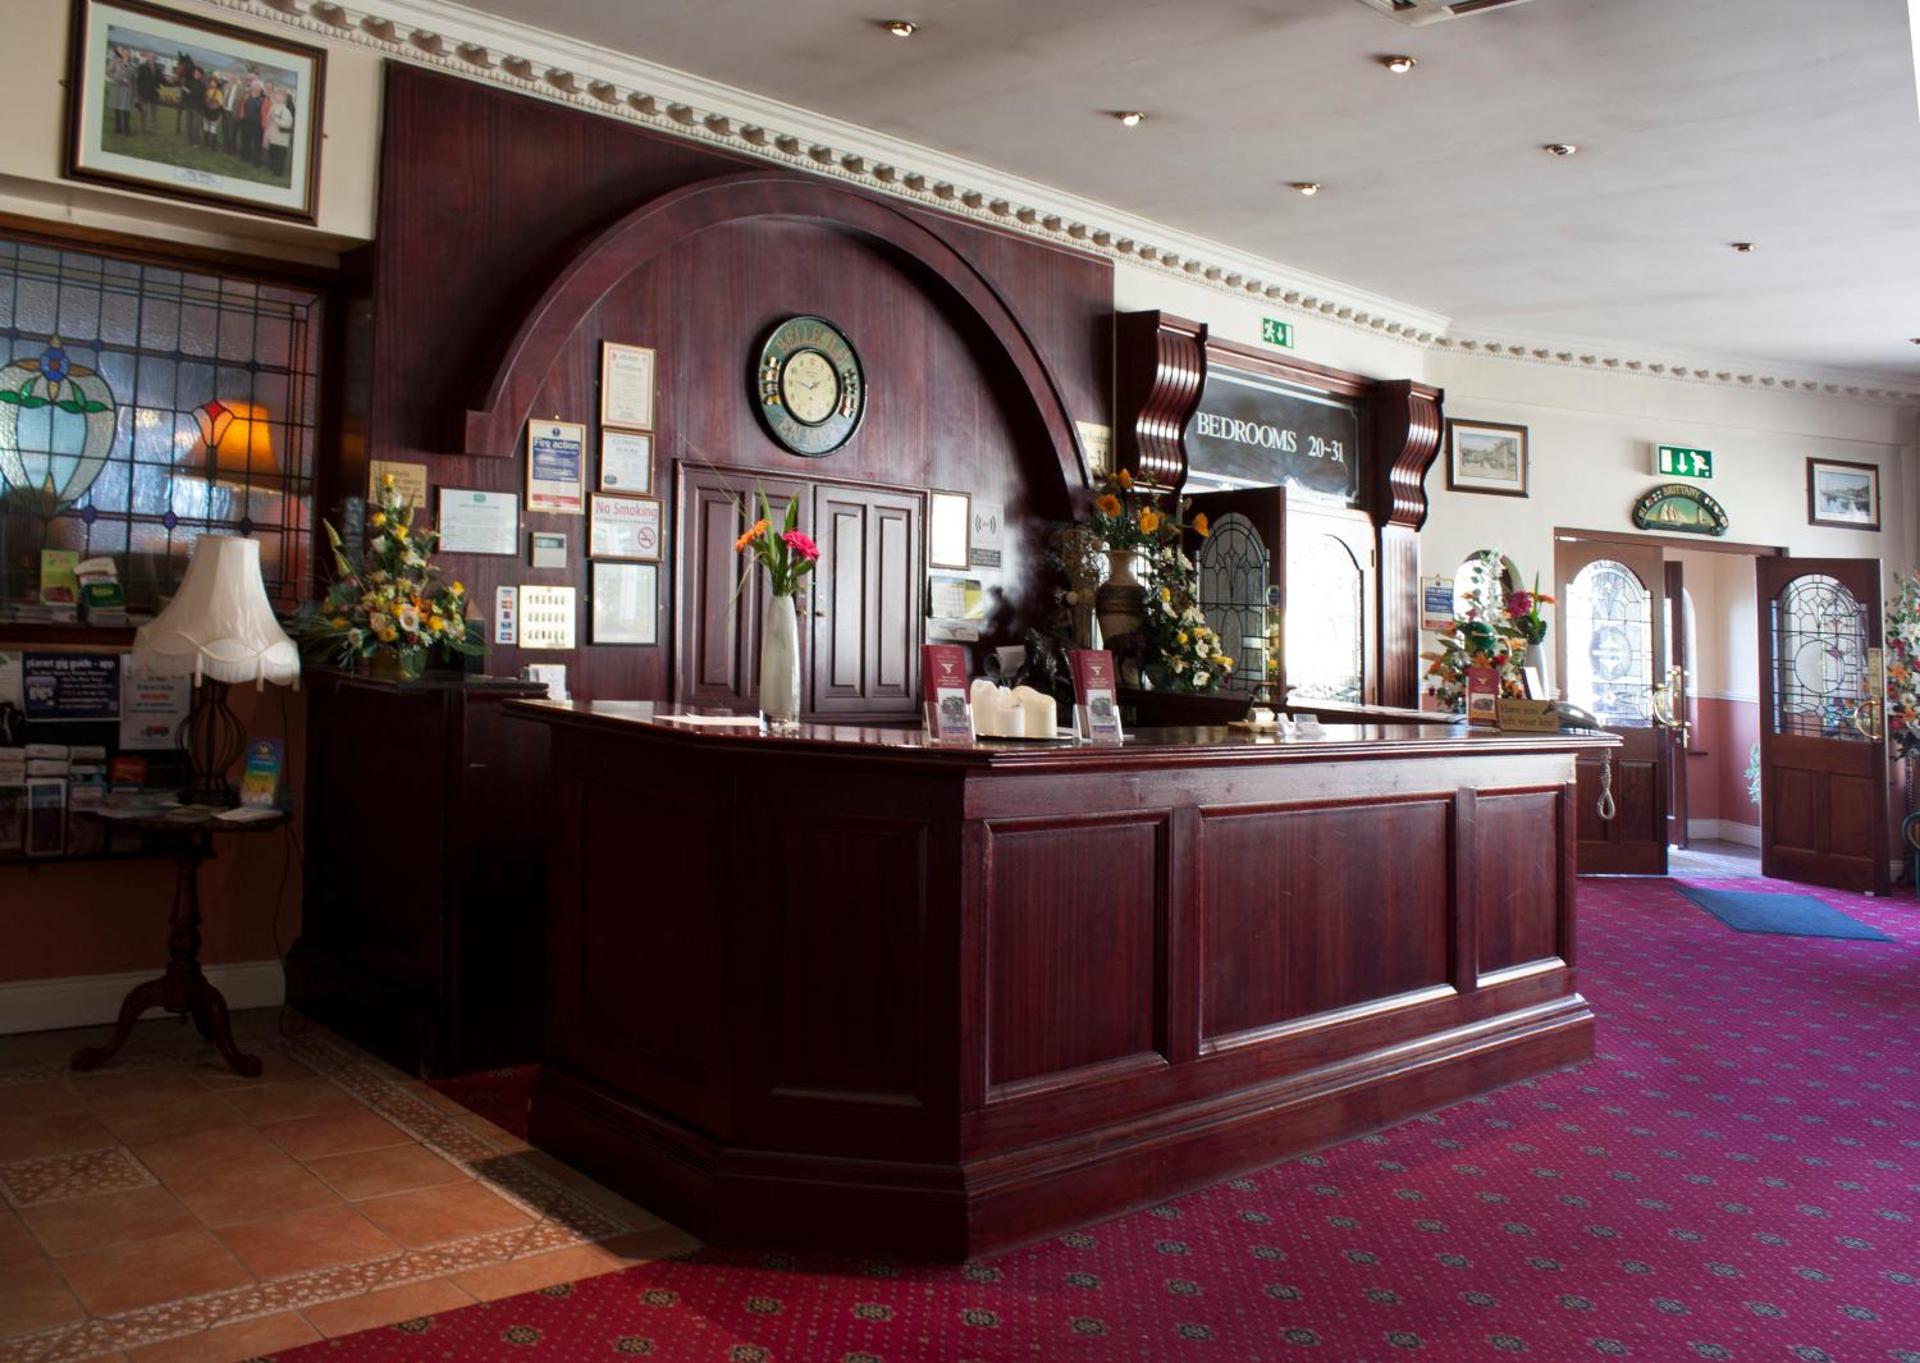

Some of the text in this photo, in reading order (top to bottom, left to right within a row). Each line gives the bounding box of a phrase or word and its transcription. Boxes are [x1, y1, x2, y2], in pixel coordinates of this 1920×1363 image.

[1196, 412, 1298, 453] BEDROOMS
[533, 438, 580, 451] Fire action
[1662, 484, 1701, 501] BRITTANY
[596, 502, 658, 520] No Smoking
[26, 657, 54, 669] planet
[55, 657, 69, 670] gig
[69, 657, 92, 671] guide
